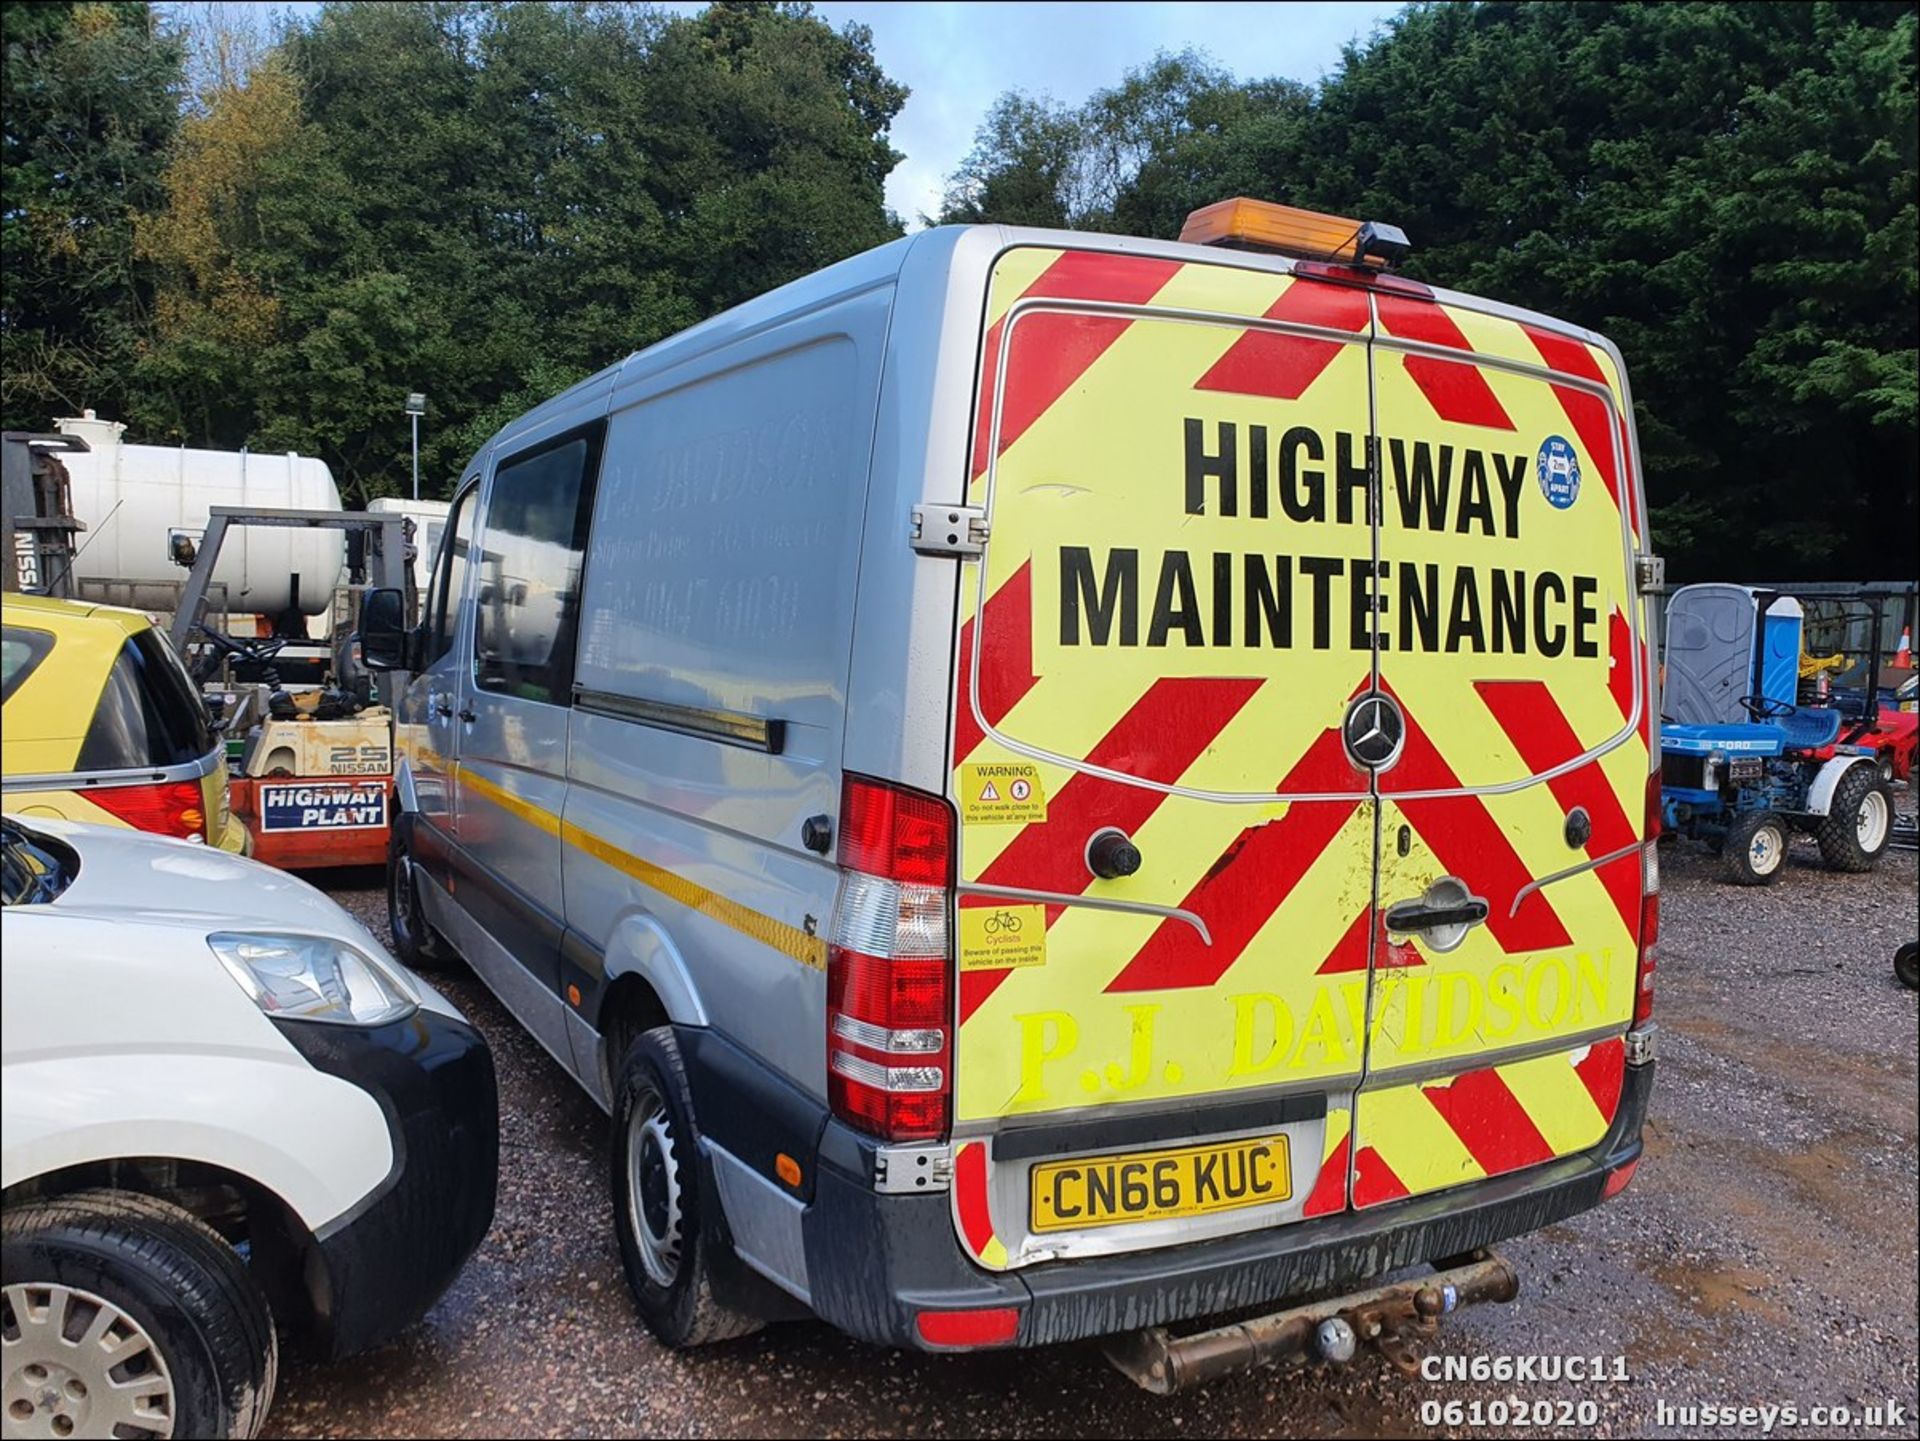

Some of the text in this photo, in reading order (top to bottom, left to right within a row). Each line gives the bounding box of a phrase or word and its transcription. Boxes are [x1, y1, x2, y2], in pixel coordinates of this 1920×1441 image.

[1184, 417, 1528, 539] HIGHWAY
[1060, 546, 1598, 658] MAINTENANCE
[1718, 740, 1751, 750] FORD
[330, 746, 388, 762] 25
[331, 763, 388, 773] NISSAN
[977, 766, 1032, 777] WARNING
[267, 788, 382, 808] HIGHWAY
[969, 804, 980, 812] Do
[1012, 803, 1030, 811] close
[302, 807, 381, 826] PLANT
[980, 813, 1005, 821] vehicle
[985, 934, 1022, 946] Cyclists
[964, 949, 991, 957] Beware
[1000, 946, 1029, 956] passing
[1030, 945, 1042, 953] this
[968, 958, 993, 966] vehicle
[1018, 955, 1039, 963] inside
[1011, 947, 1613, 1105] P.J. DAVIDSON
[1053, 1146, 1273, 1219] CN66 KUC
